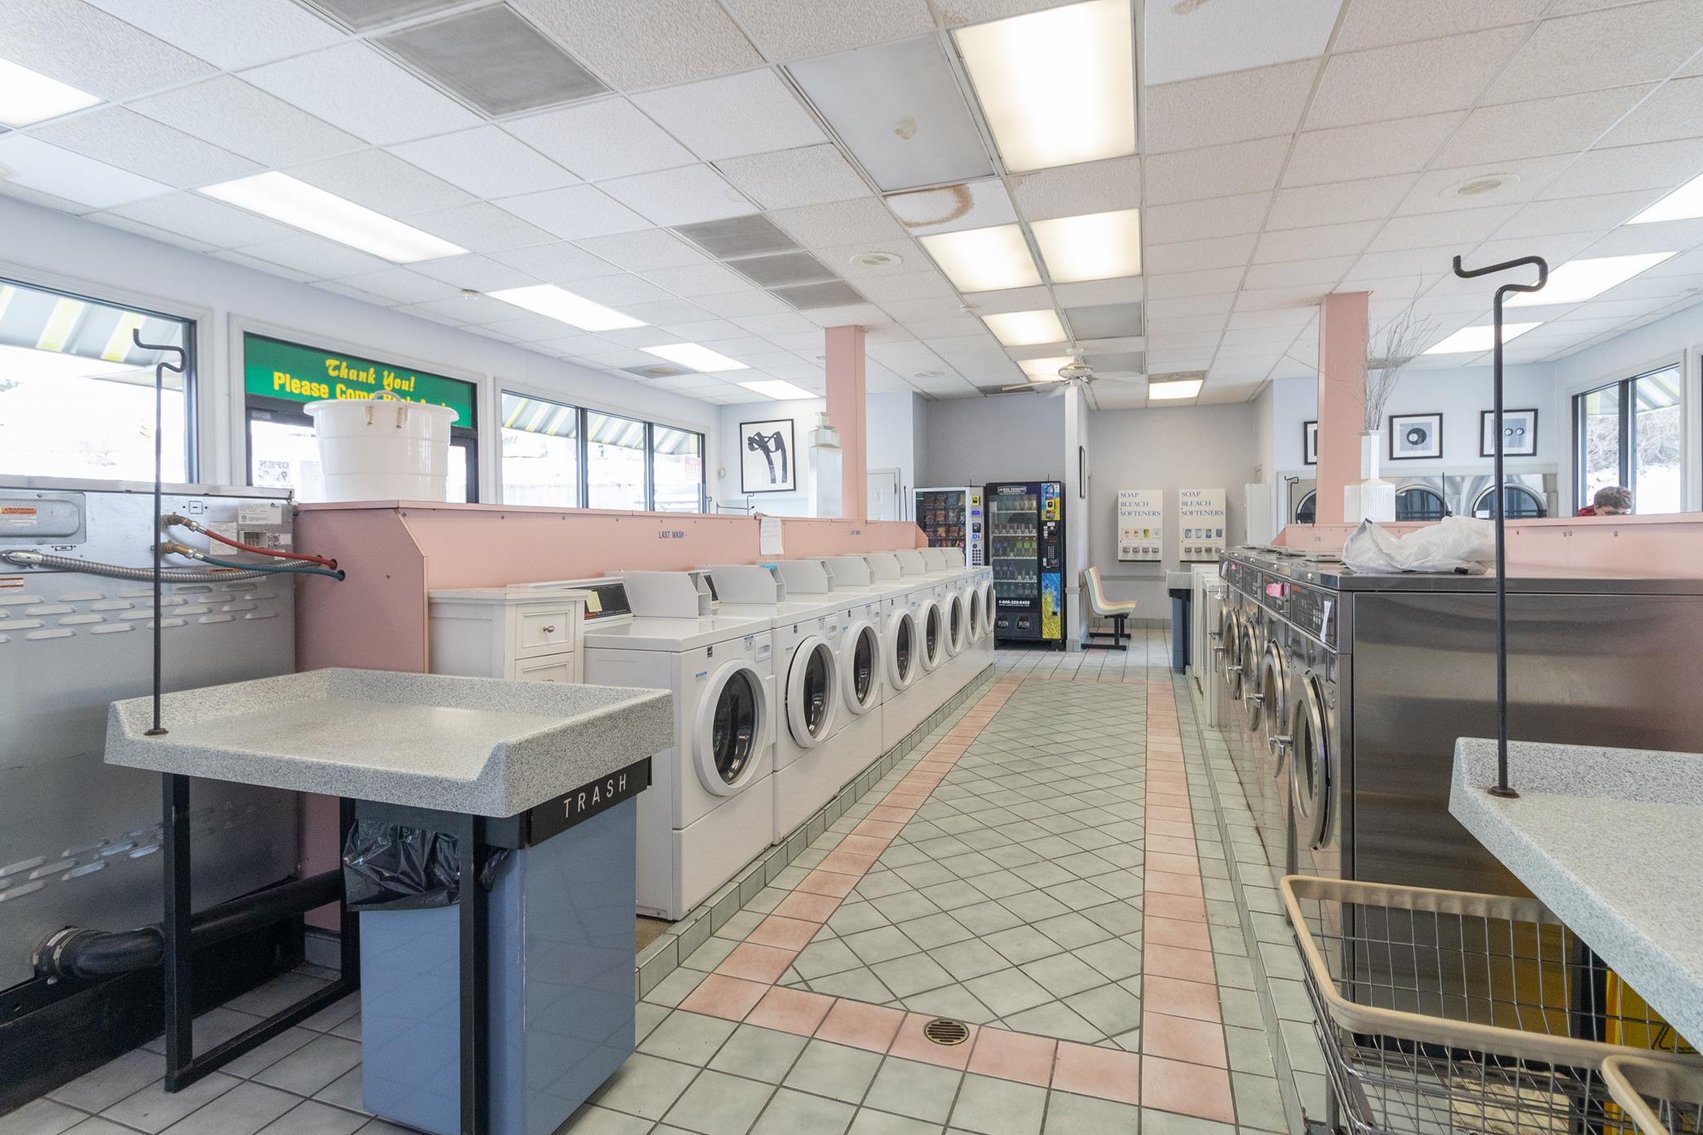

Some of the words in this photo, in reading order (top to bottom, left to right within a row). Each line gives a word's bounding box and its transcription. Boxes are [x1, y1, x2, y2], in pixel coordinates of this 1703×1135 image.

[273, 371, 330, 399] Please
[325, 359, 376, 384] Thank
[382, 370, 416, 392] You!
[1181, 509, 1224, 517] SOFTENERS
[658, 531, 671, 539] LAST
[672, 531, 685, 539] WASH
[563, 773, 627, 819] TRASH
